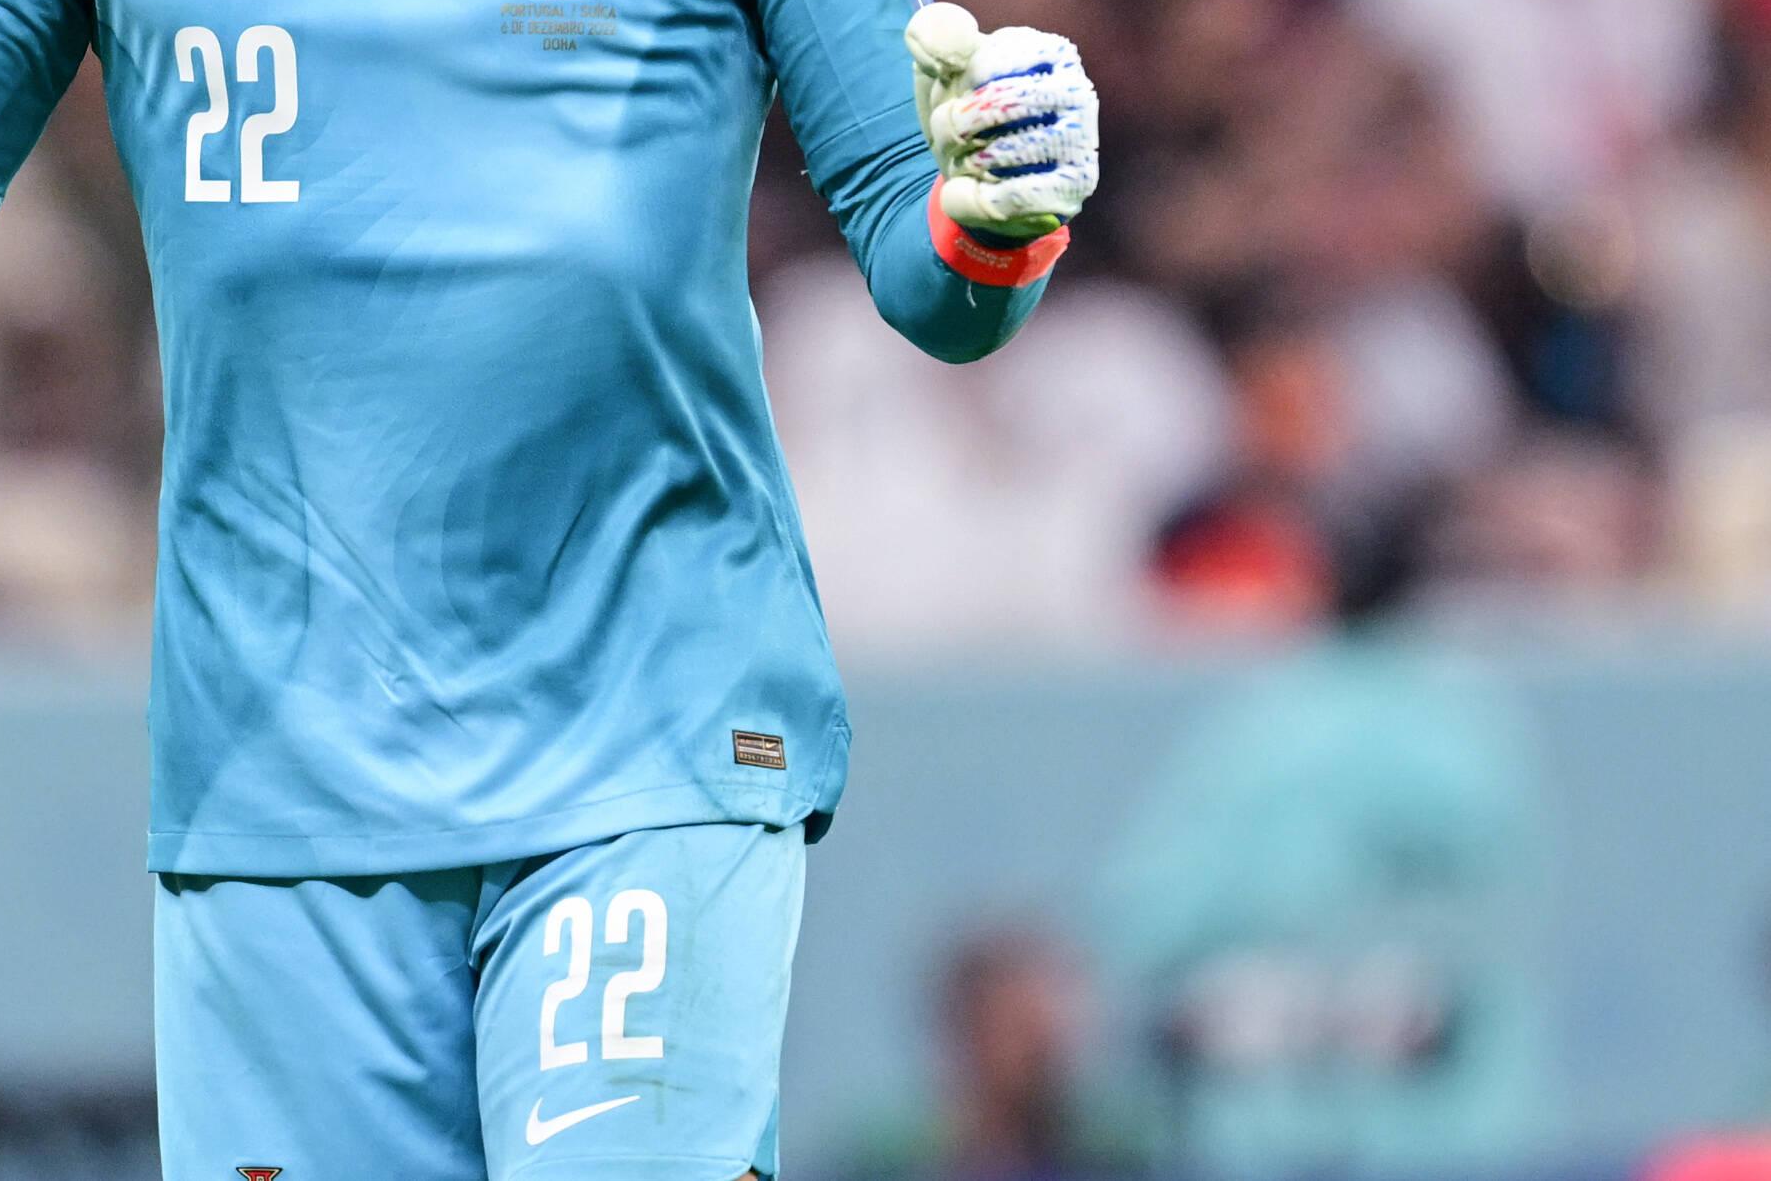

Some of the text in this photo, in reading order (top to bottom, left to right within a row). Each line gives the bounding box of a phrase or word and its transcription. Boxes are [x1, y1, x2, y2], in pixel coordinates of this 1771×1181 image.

[500, 3, 564, 18] PORTUGAL
[511, 20, 524, 34] DE
[528, 21, 585, 35] DEZEMBRO
[543, 38, 578, 51] DOHA
[174, 24, 300, 203] 22
[540, 889, 668, 1072] 22
